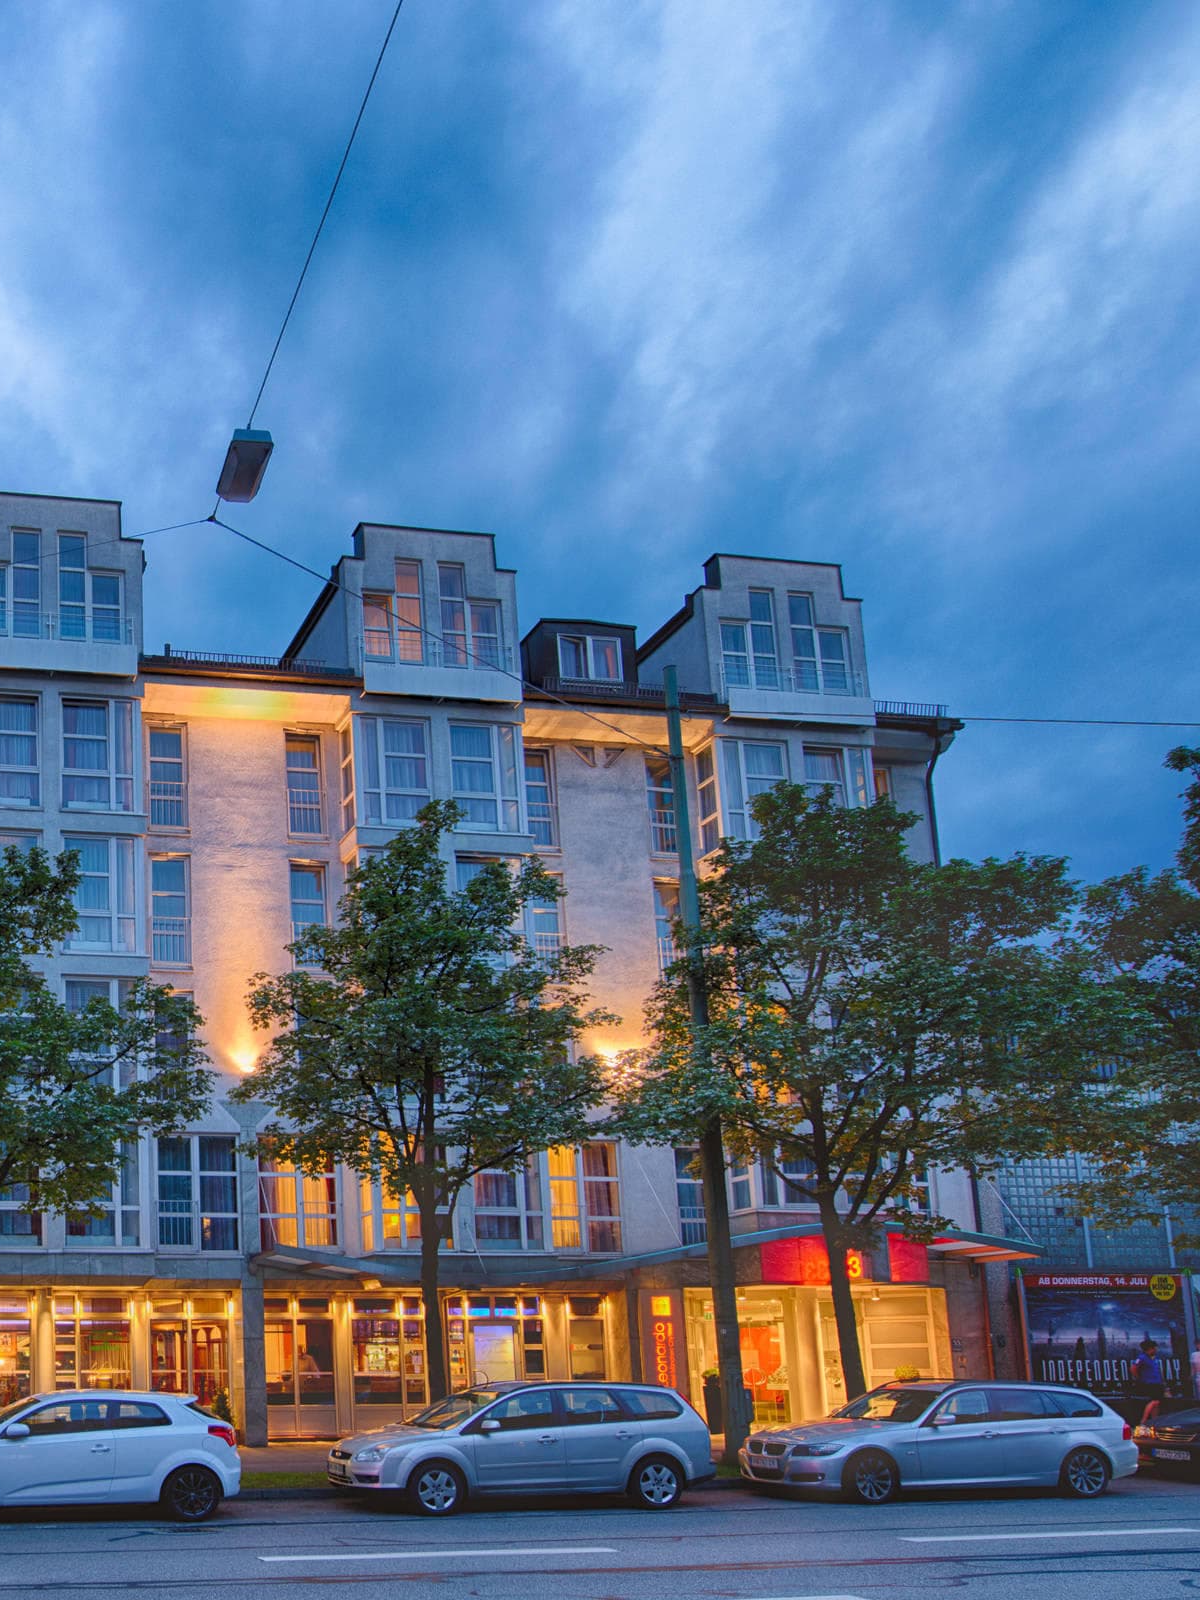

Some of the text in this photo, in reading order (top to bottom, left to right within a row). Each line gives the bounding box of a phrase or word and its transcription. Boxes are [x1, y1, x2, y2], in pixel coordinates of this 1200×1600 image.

[1038, 1277, 1148, 1286] AB DONNERSTAG, 14. JULI
[1042, 1359, 1146, 1382] INDEPENDEN
